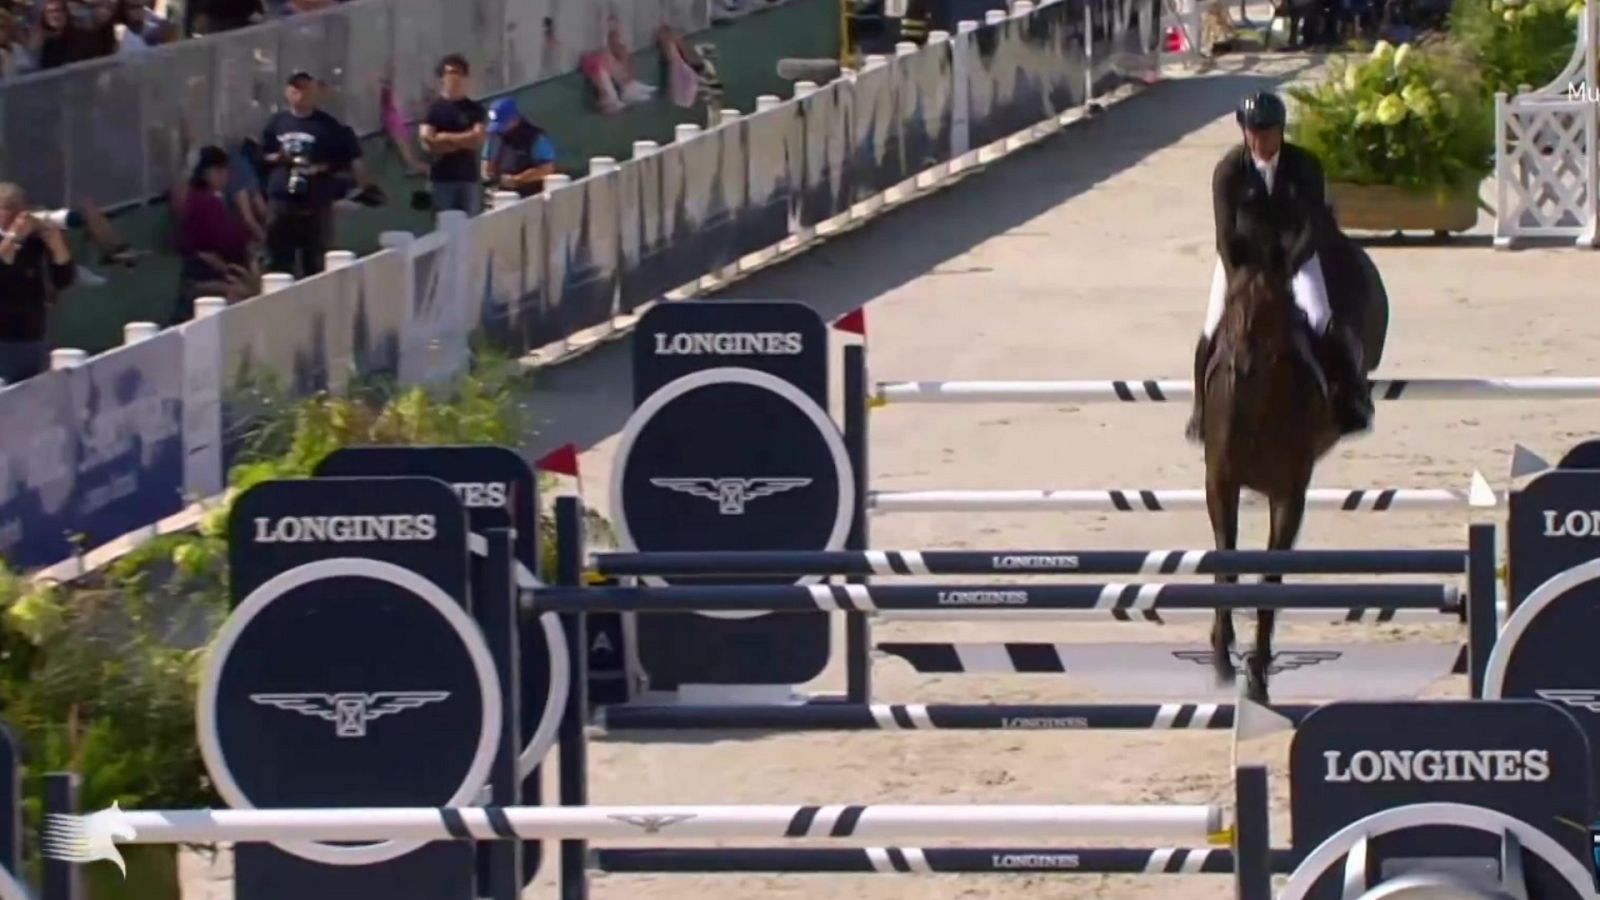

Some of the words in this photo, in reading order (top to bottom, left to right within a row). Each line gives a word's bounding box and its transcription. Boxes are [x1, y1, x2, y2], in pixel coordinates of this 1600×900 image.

[654, 332, 803, 355] LONGINES
[254, 514, 437, 542] LONGINES
[992, 555, 1079, 568] LONGINES
[938, 591, 1028, 604] LONGINES
[1323, 749, 1550, 782] LONGINES
[992, 854, 1079, 869] LONGINES
